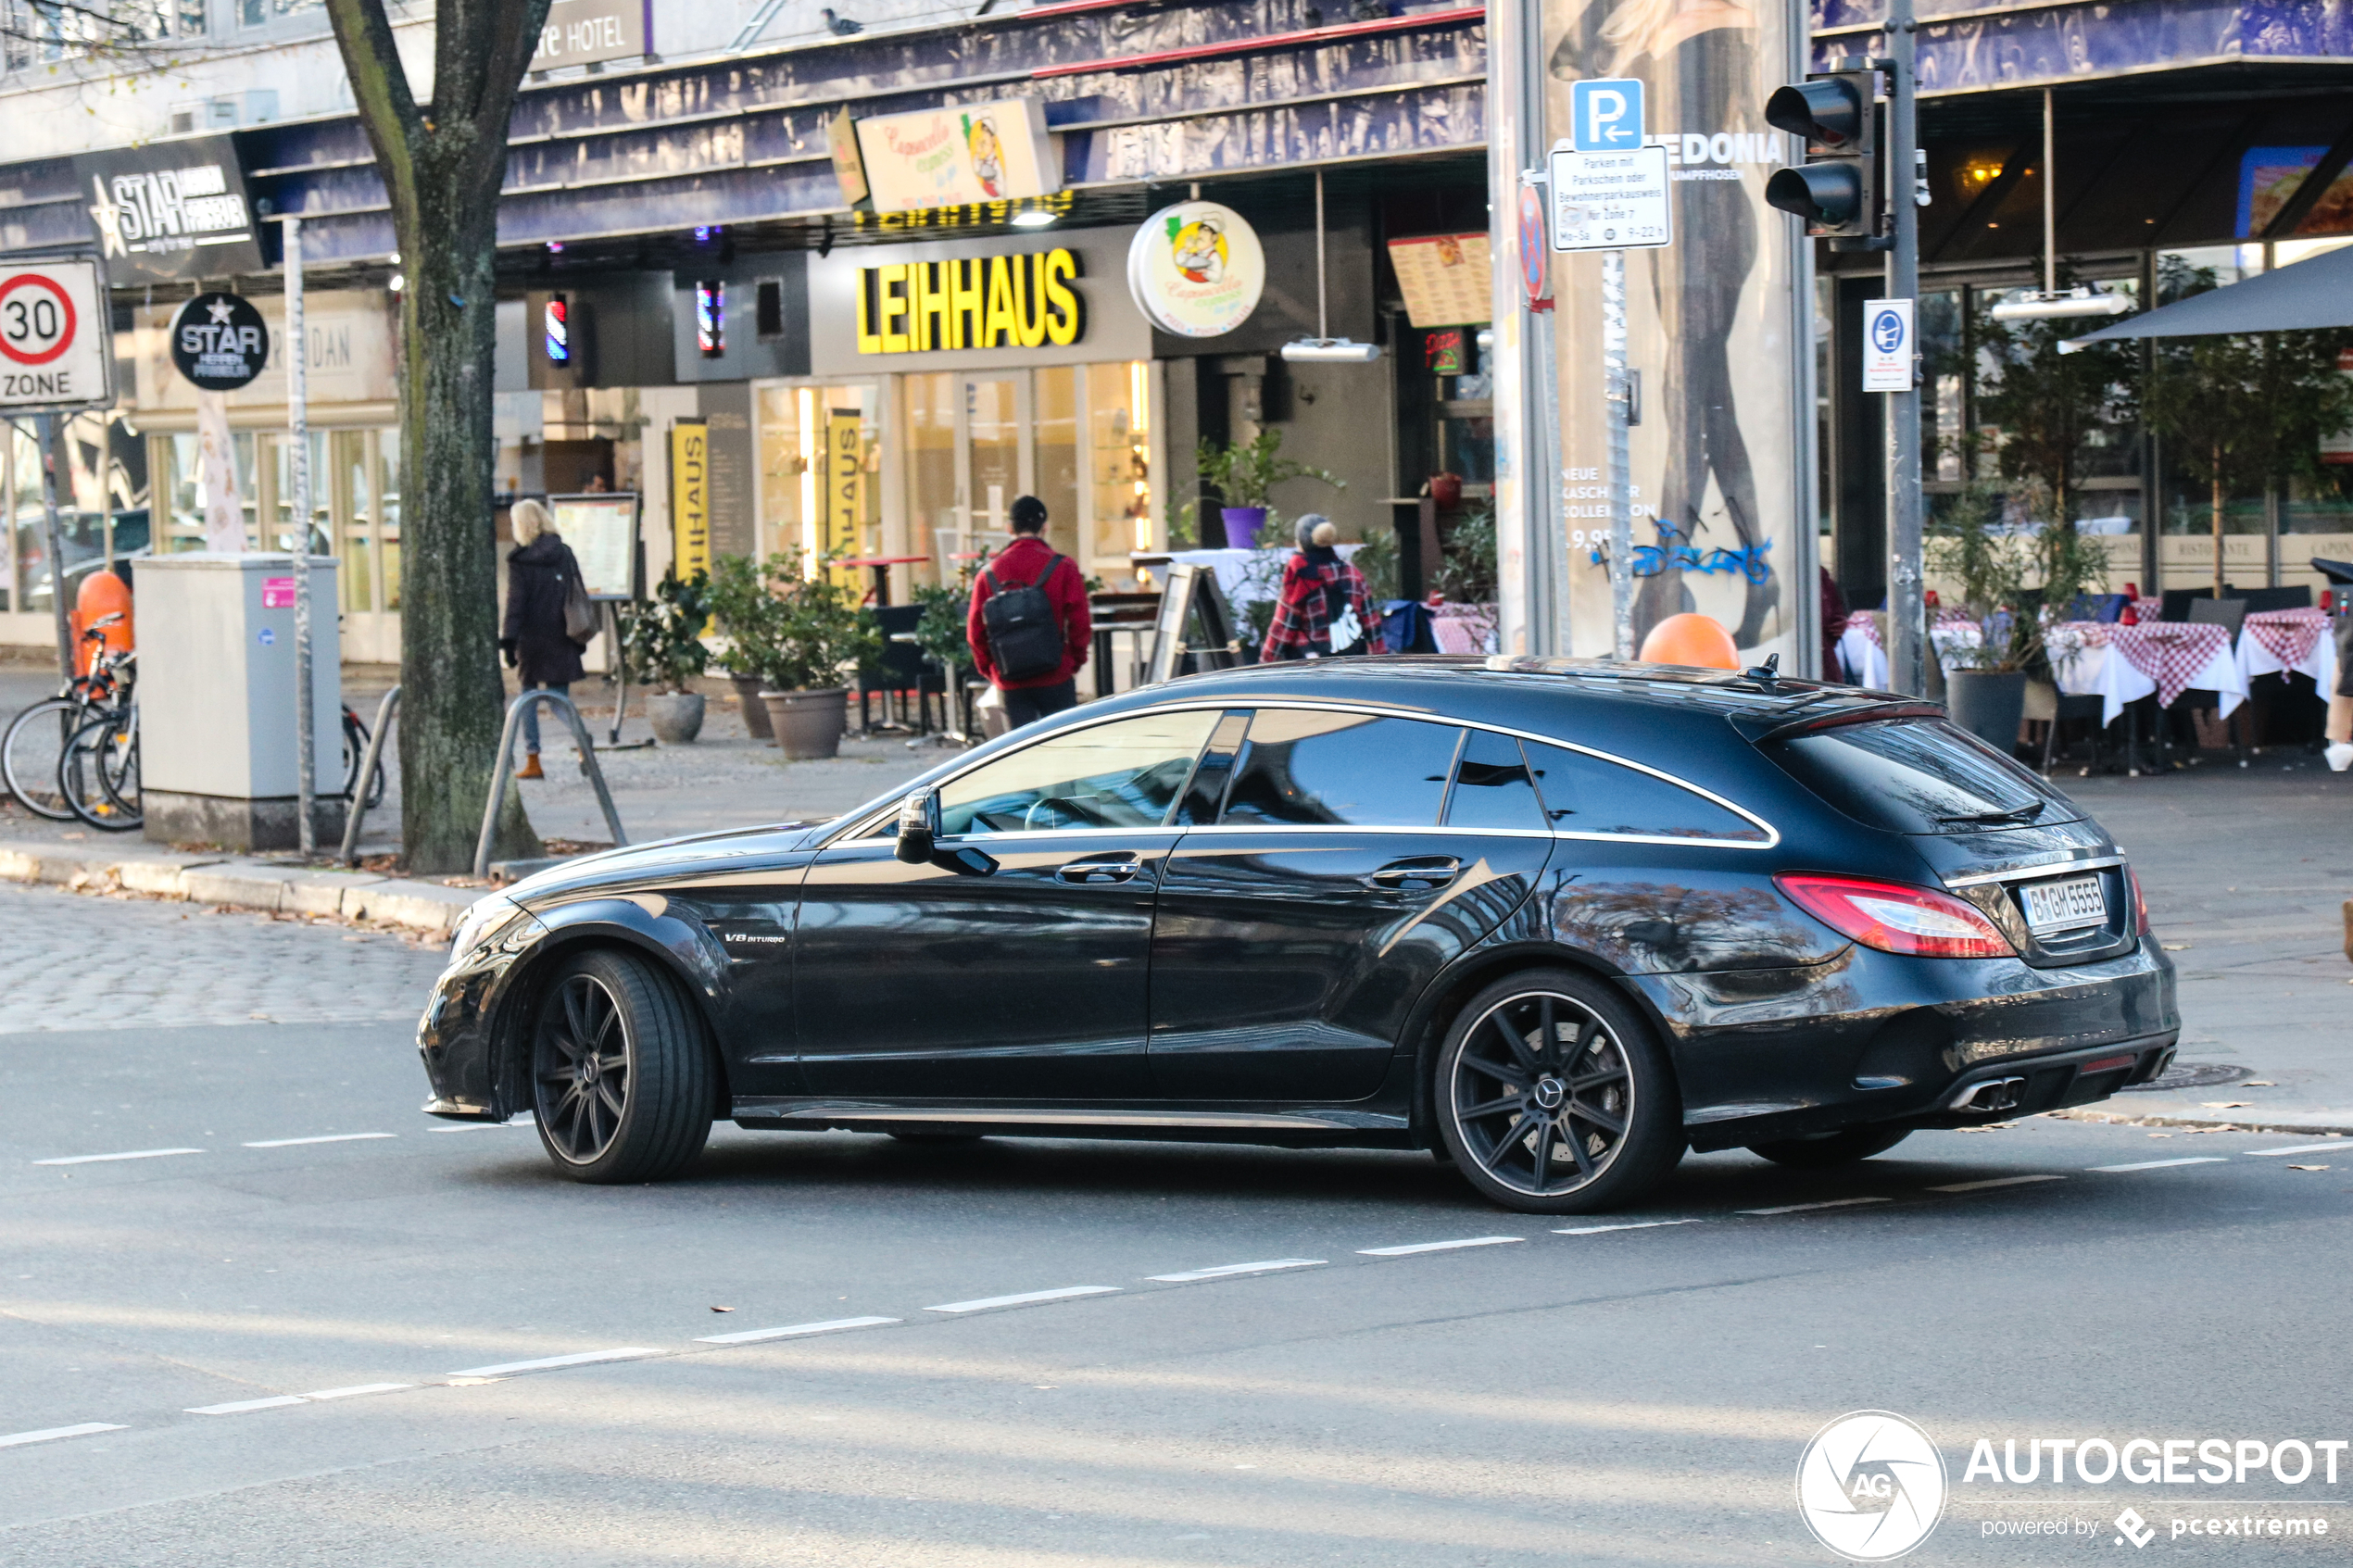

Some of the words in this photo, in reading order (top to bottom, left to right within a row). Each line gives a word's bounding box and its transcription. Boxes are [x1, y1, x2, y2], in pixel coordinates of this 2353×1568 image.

[566, 16, 626, 52] HOTEL
[1589, 90, 1627, 144] P
[1645, 132, 1783, 165] EDONIA
[1584, 157, 1616, 169] Parken
[1618, 156, 1634, 168] mit
[1572, 173, 1622, 185] Parkschein
[1626, 171, 1646, 183] oder
[113, 171, 184, 240] STAR
[1558, 187, 1663, 204] Bewohnerparkausweis
[1604, 209, 1626, 220] Zone
[1628, 209, 1635, 220] 7
[1560, 230, 1591, 241] Mo-Sa
[856, 247, 1078, 354] LEIHHAUS
[6, 299, 57, 340] 30
[181, 325, 260, 354] STAR
[4, 372, 71, 396] ZONE
[1563, 485, 1641, 499] KASCHR
[1564, 503, 1656, 519] OLLEON
[2030, 890, 2044, 922] B
[2067, 882, 2102, 915] 5555
[724, 934, 747, 942] V8
